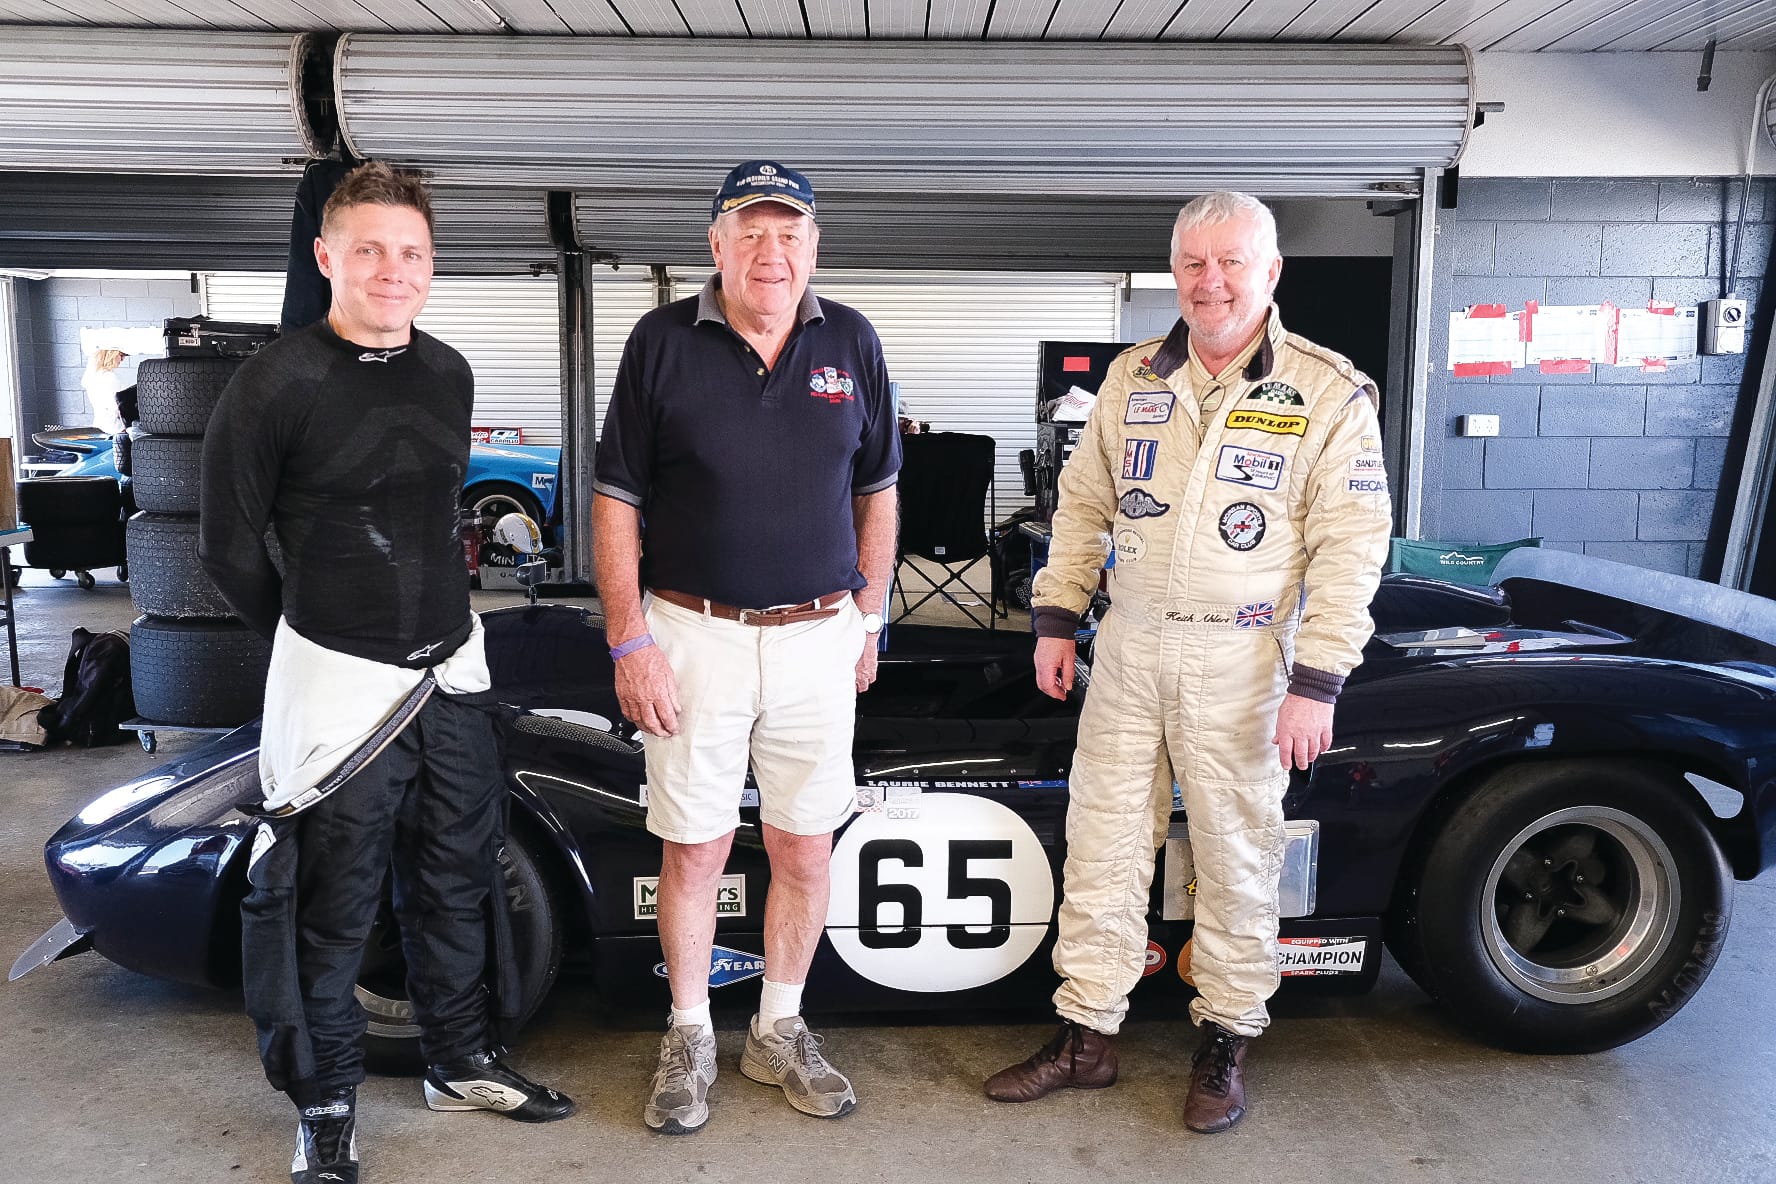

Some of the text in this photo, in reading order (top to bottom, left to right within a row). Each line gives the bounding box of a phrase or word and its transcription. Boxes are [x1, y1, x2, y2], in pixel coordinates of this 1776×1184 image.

[1232, 415, 1301, 429] DUNLOP
[1233, 454, 1267, 469] Mobil
[867, 780, 1010, 788] LAURIE BENNETT
[740, 793, 753, 801] SIC
[888, 808, 920, 820] 2017
[858, 839, 1013, 949] 65
[1328, 937, 1350, 945] WITH
